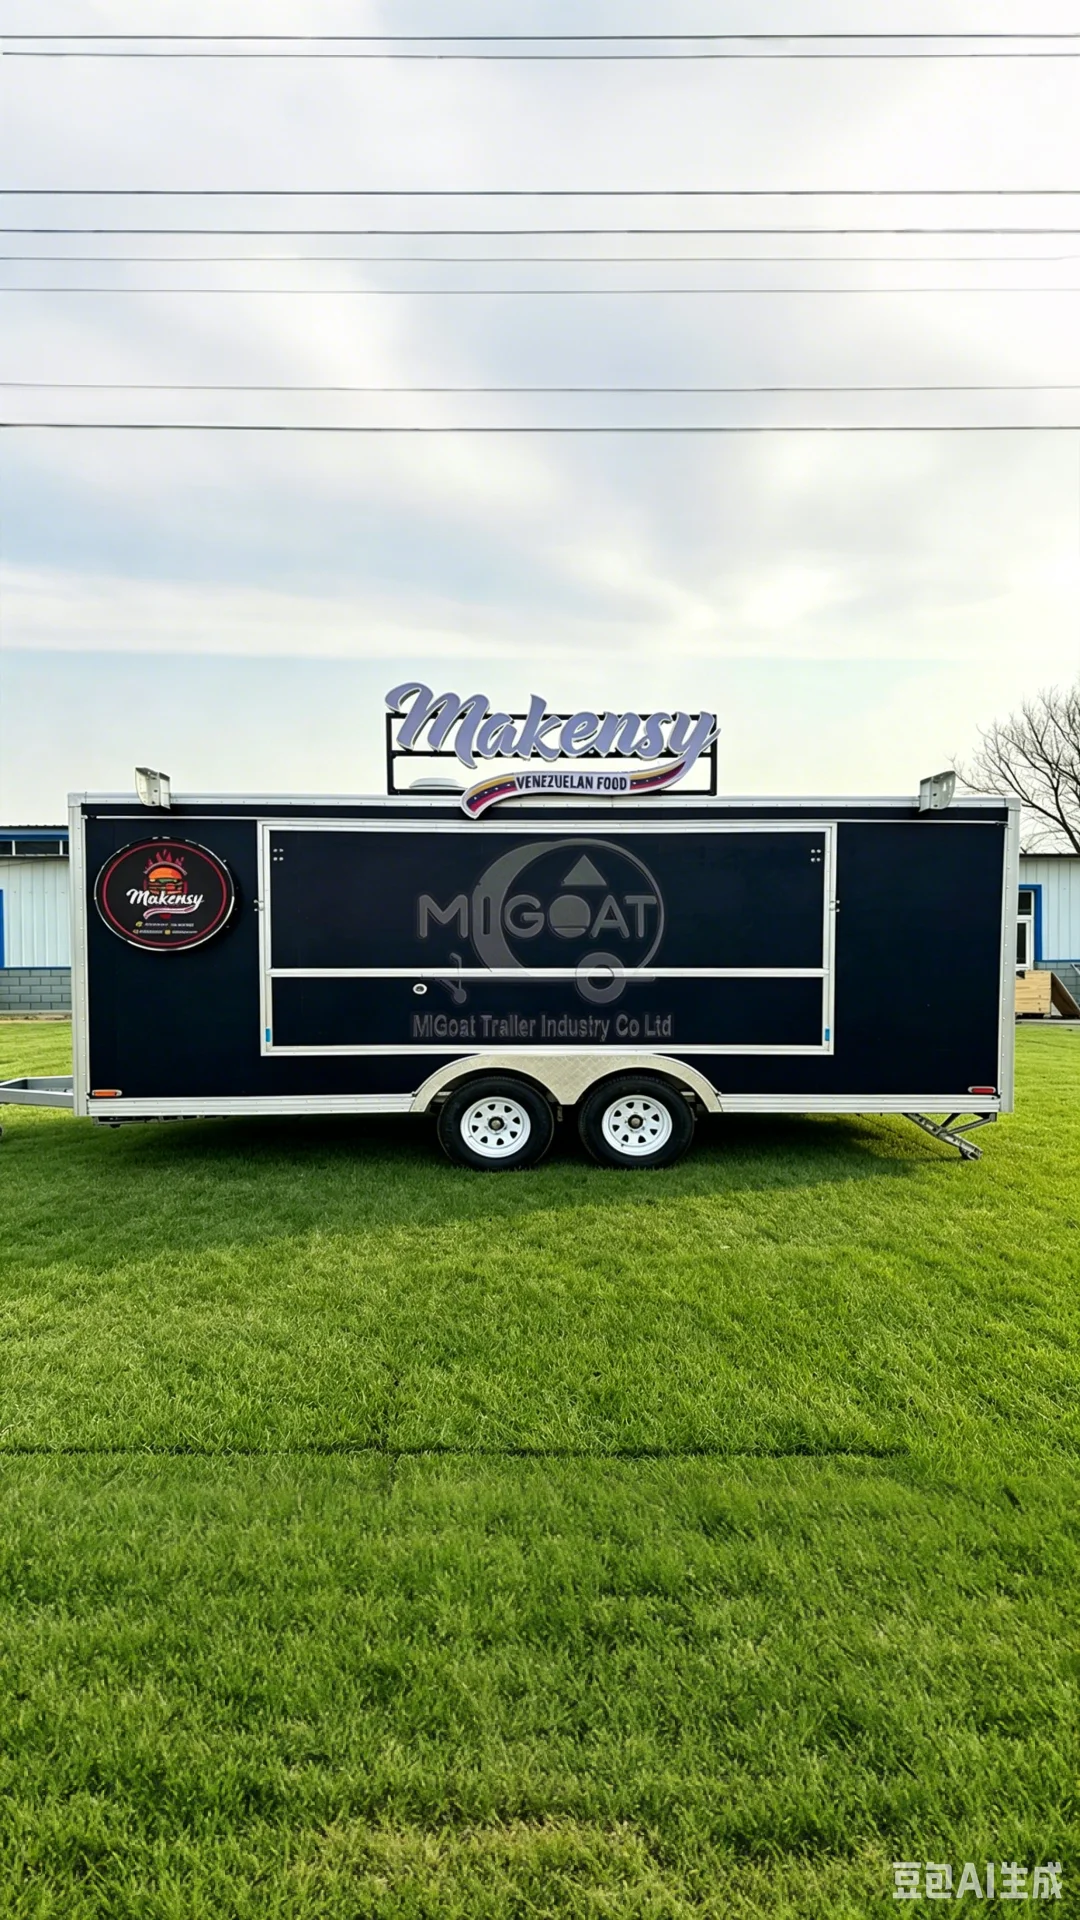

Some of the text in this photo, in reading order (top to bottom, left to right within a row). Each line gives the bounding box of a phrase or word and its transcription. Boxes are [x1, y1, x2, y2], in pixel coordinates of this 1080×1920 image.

[385, 682, 721, 772] Makensy
[516, 775, 627, 790] VENEZUELAN FOOD
[126, 888, 204, 910] Makensy
